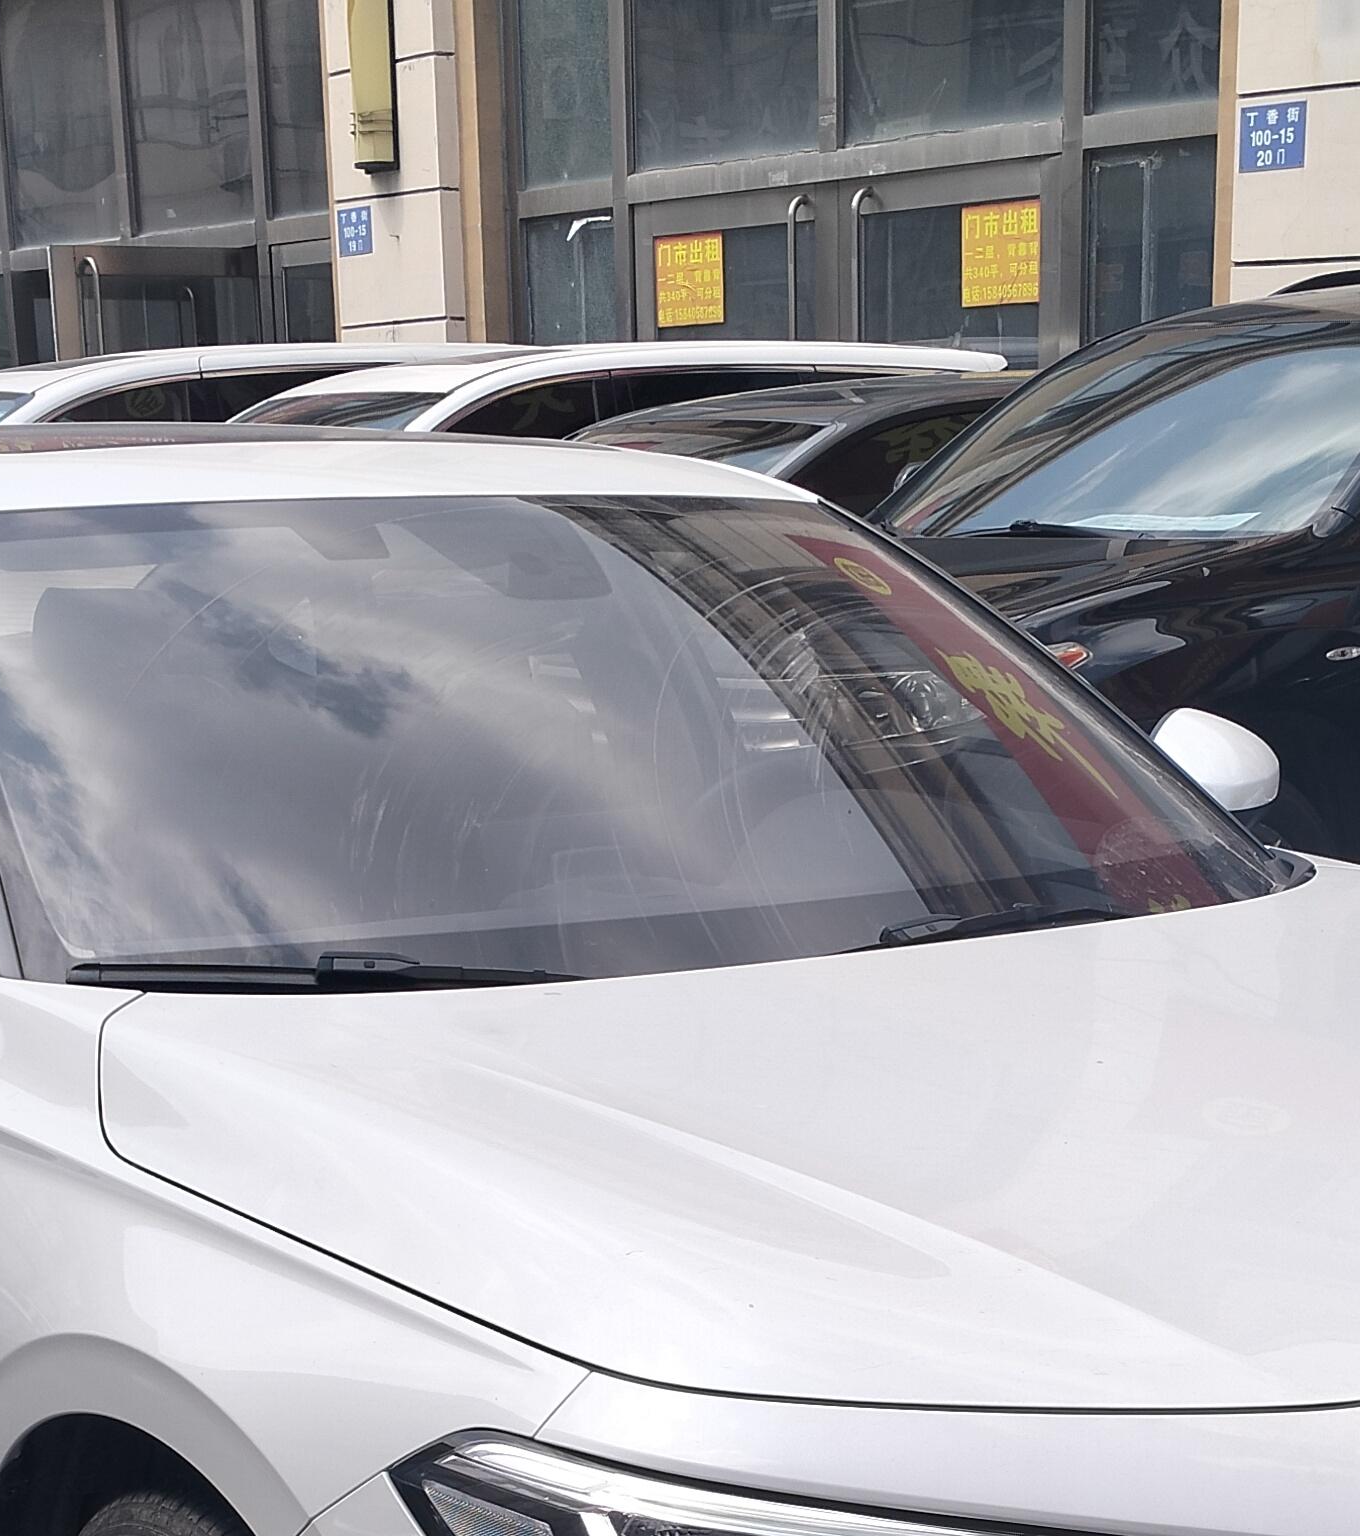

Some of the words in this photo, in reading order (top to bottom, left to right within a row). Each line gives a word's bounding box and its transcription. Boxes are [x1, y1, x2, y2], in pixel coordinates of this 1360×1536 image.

[1246, 106, 1300, 127] 丁香街
[1250, 127, 1295, 147] 100-15
[964, 207, 1038, 240] 门市出租
[657, 238, 720, 267] 门市出租
